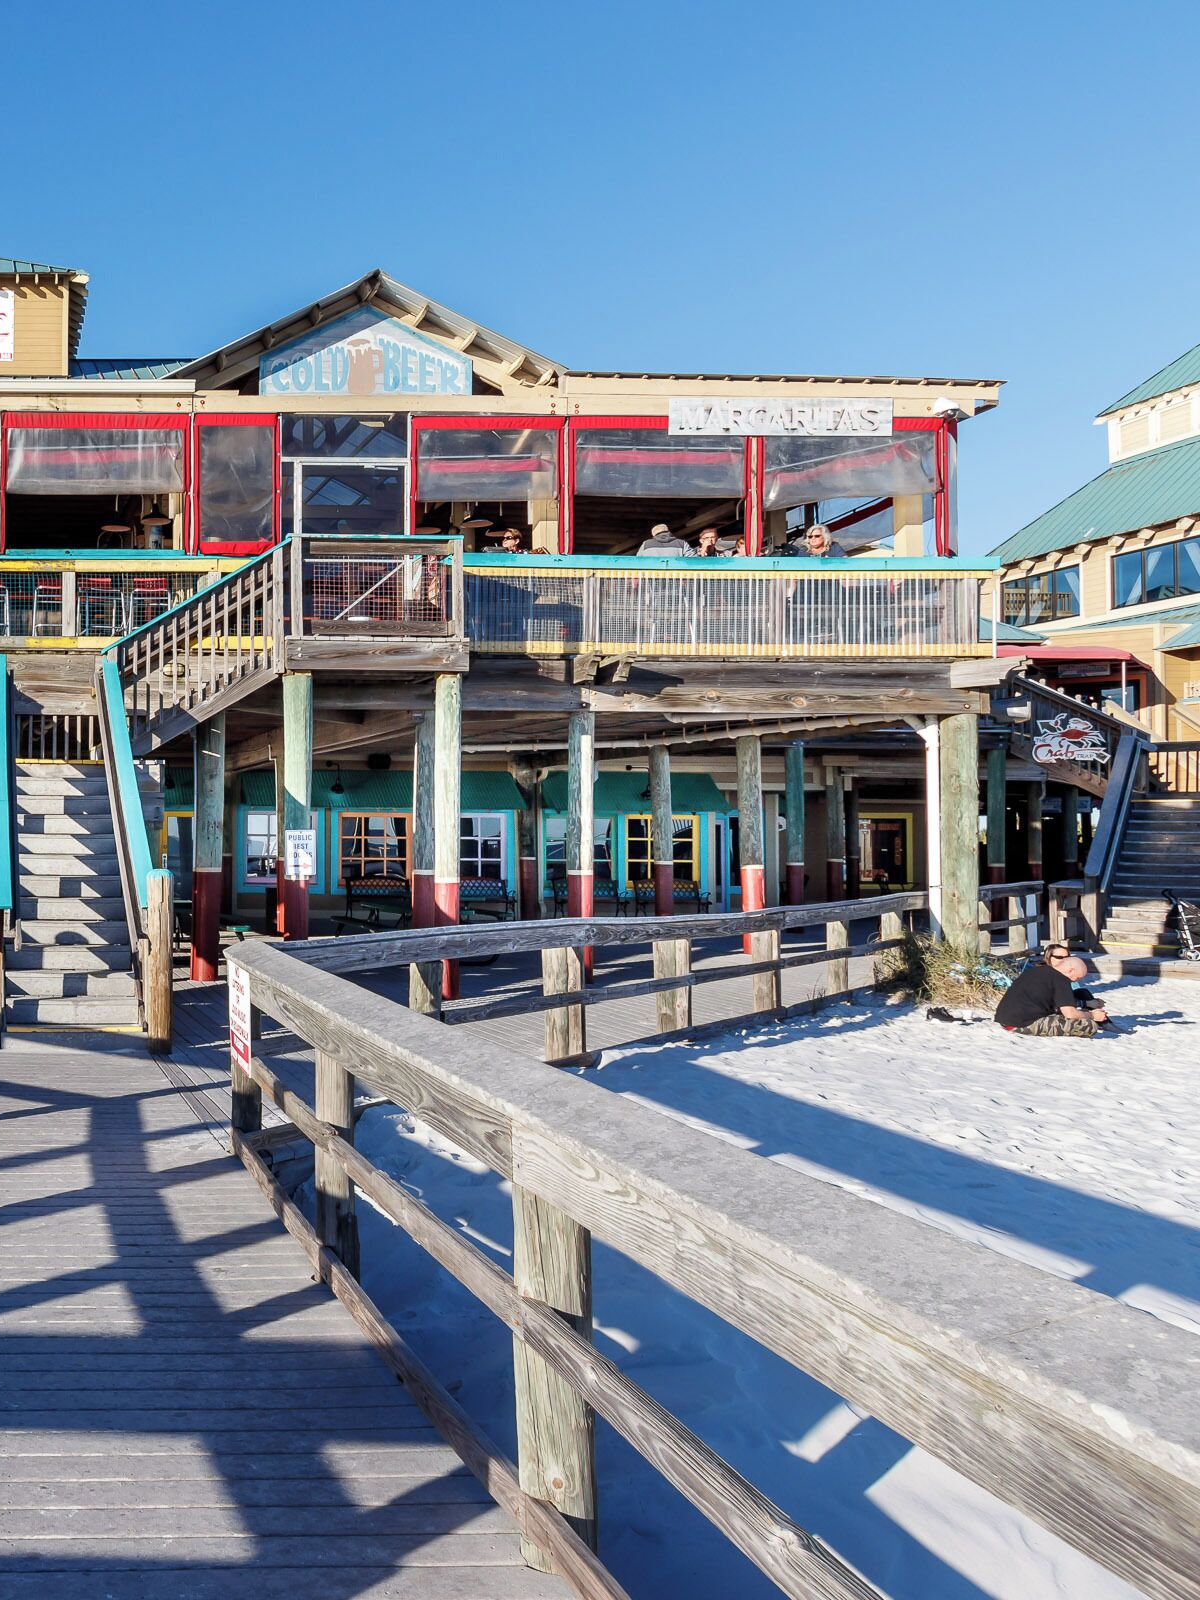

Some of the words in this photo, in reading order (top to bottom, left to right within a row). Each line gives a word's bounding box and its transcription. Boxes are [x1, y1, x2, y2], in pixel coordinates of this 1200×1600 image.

[271, 346, 349, 392] COLD
[379, 336, 463, 393] BEER
[679, 402, 881, 435] MARGARITAS
